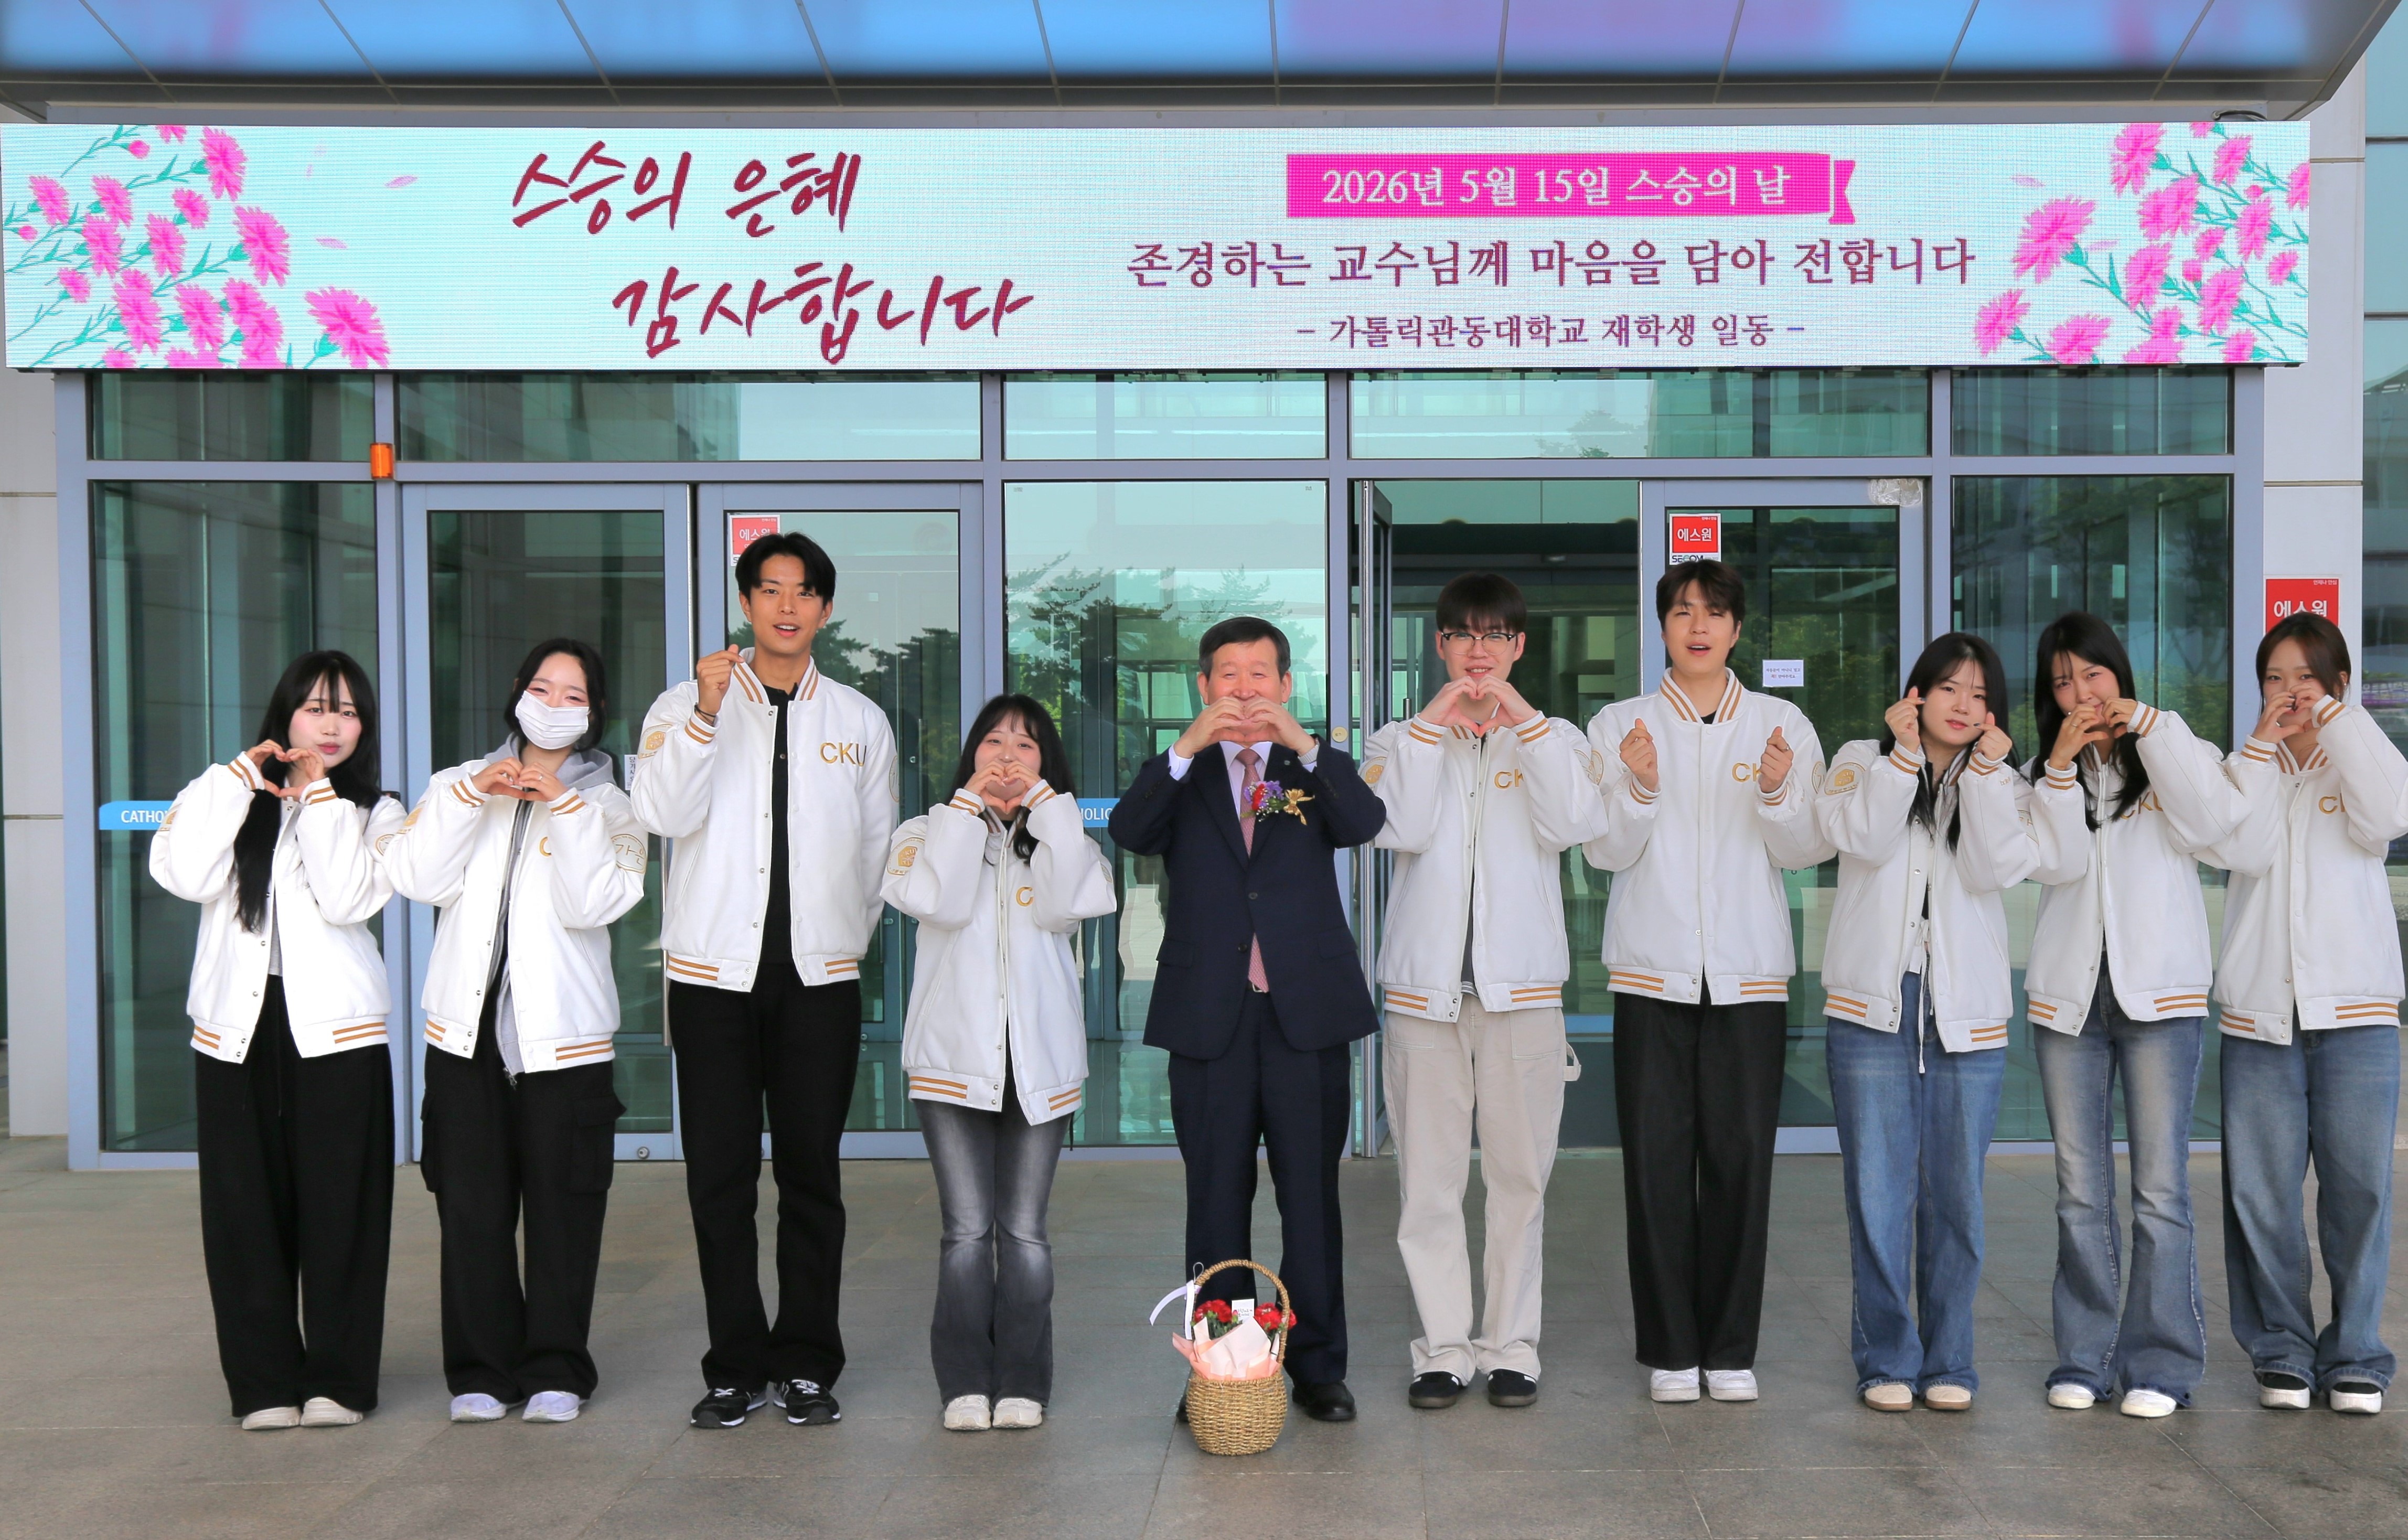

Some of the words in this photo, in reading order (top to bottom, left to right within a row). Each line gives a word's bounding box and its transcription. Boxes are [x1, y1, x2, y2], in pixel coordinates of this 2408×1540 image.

[512, 140, 692, 234] 스승의
[725, 152, 862, 238] 은혜
[1322, 167, 1444, 206] 2026년
[1460, 167, 1517, 206] 5월
[1534, 166, 1610, 206] 15일
[1625, 166, 1737, 206] 스승의
[1753, 165, 1792, 205] 날
[1127, 241, 1311, 288] 존경하는
[1329, 240, 1508, 287] 교수님께
[1529, 239, 1666, 286] 마음을
[1685, 239, 1775, 286] 담아
[1794, 237, 1976, 285] 전합니다
[612, 262, 1035, 366] 감사합니다
[1330, 314, 1589, 348] 가톨릭관동대학교
[1602, 314, 1696, 348] 재학생
[1711, 314, 1774, 347] 일동
[1677, 528, 1712, 541] 에스원
[819, 742, 867, 766] CKU
[121, 810, 167, 823] CATHO
